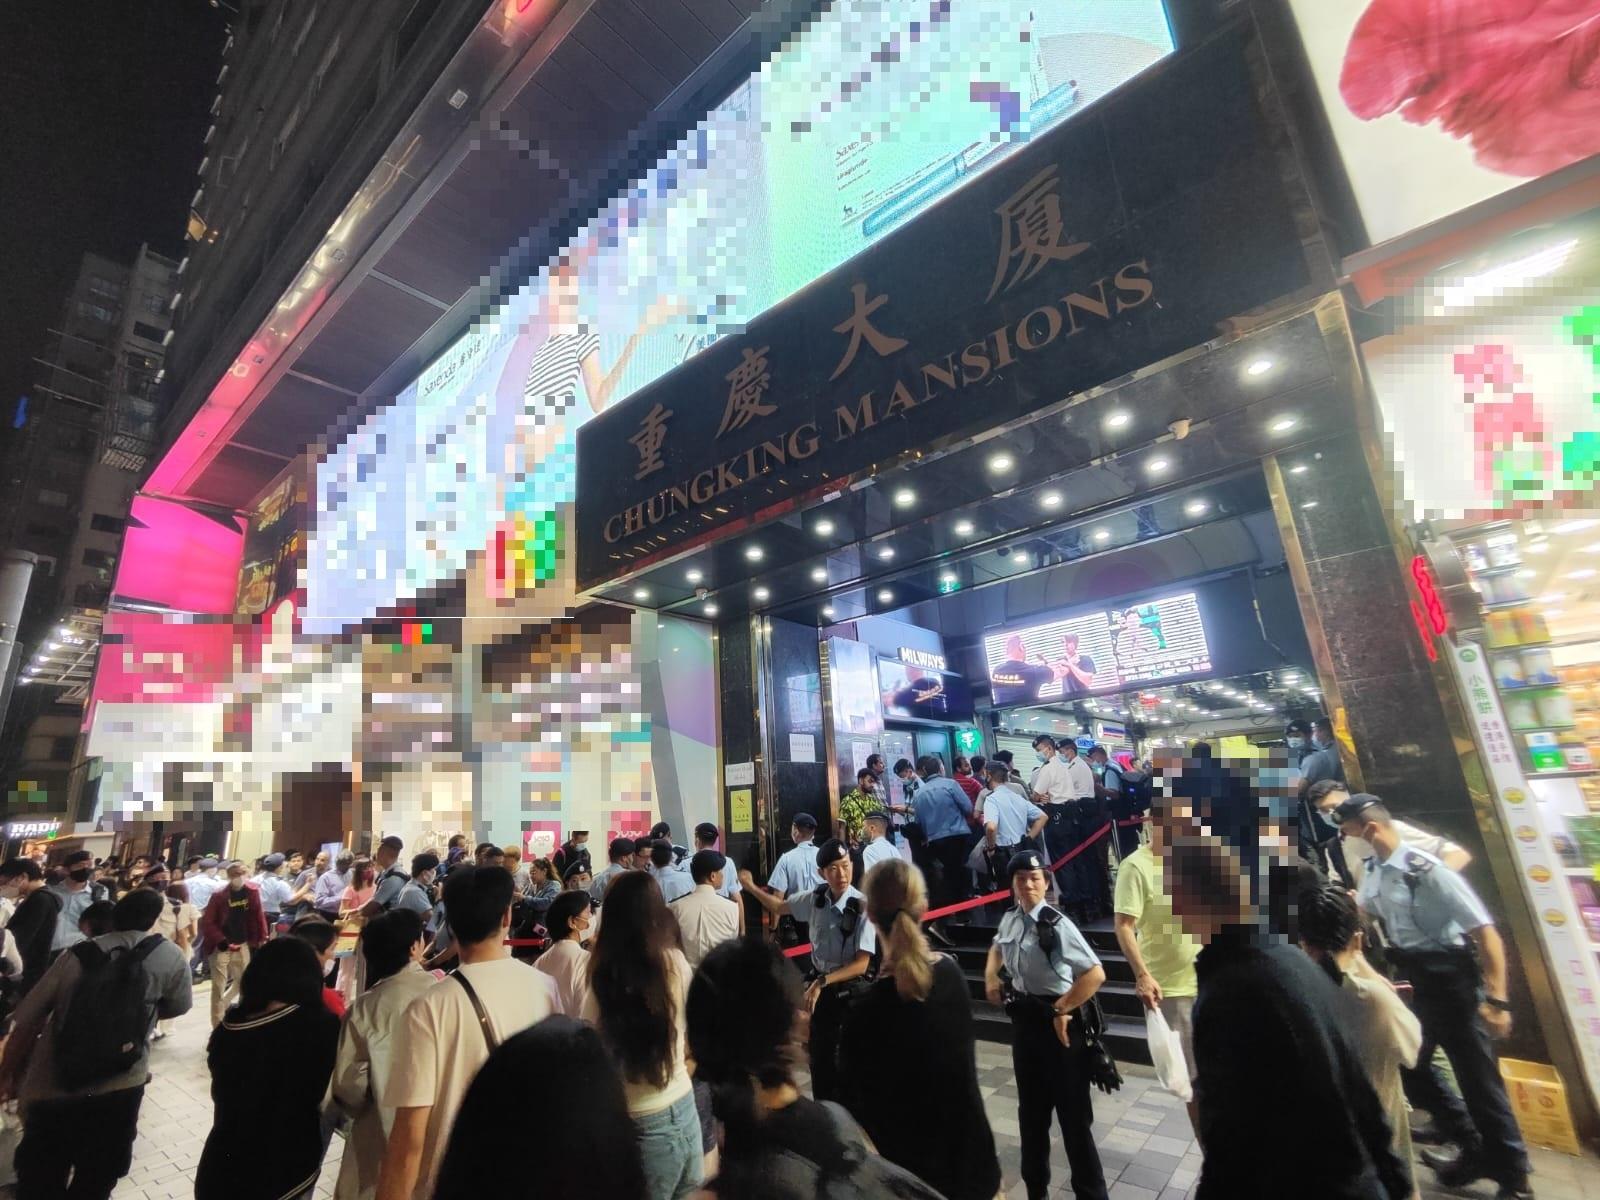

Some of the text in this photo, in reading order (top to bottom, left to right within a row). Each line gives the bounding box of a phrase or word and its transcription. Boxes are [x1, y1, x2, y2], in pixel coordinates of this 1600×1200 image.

[603, 258, 1153, 544] CHUNGKING MANSIONS
[901, 647, 945, 671] MILWAYS
